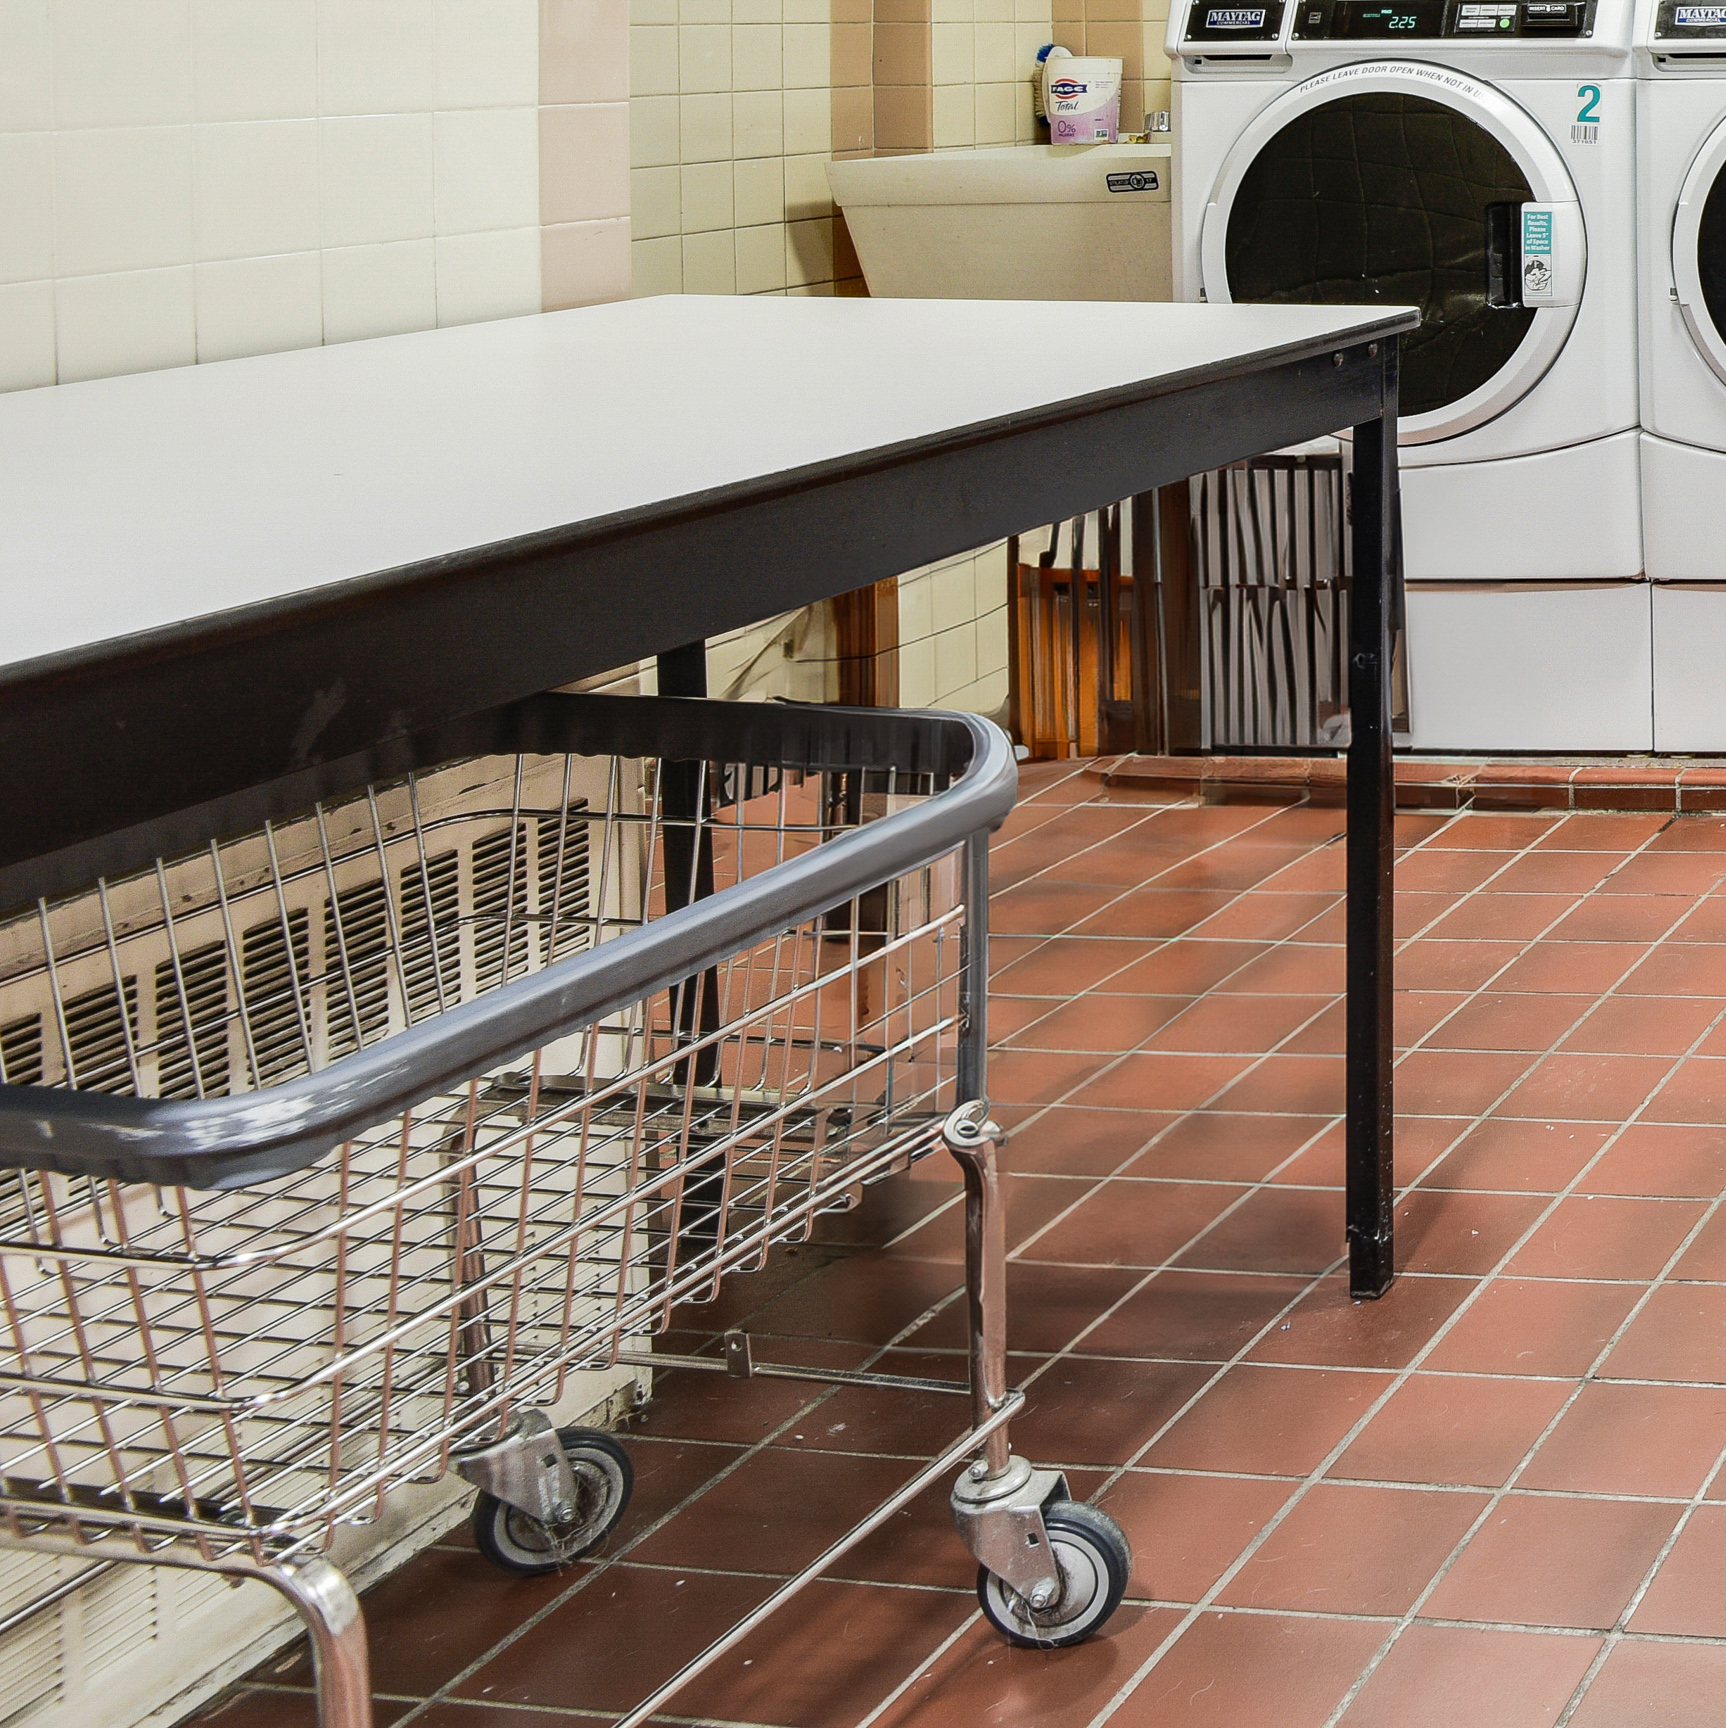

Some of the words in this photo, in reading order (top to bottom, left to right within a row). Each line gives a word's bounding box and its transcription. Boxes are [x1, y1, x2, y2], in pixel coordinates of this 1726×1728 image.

[1210, 11, 1261, 23] MAYTAG
[1388, 16, 1416, 29] 2.25
[1056, 101, 1079, 111] Total
[1576, 85, 1601, 123] 2
[1058, 121, 1076, 133] 0%
